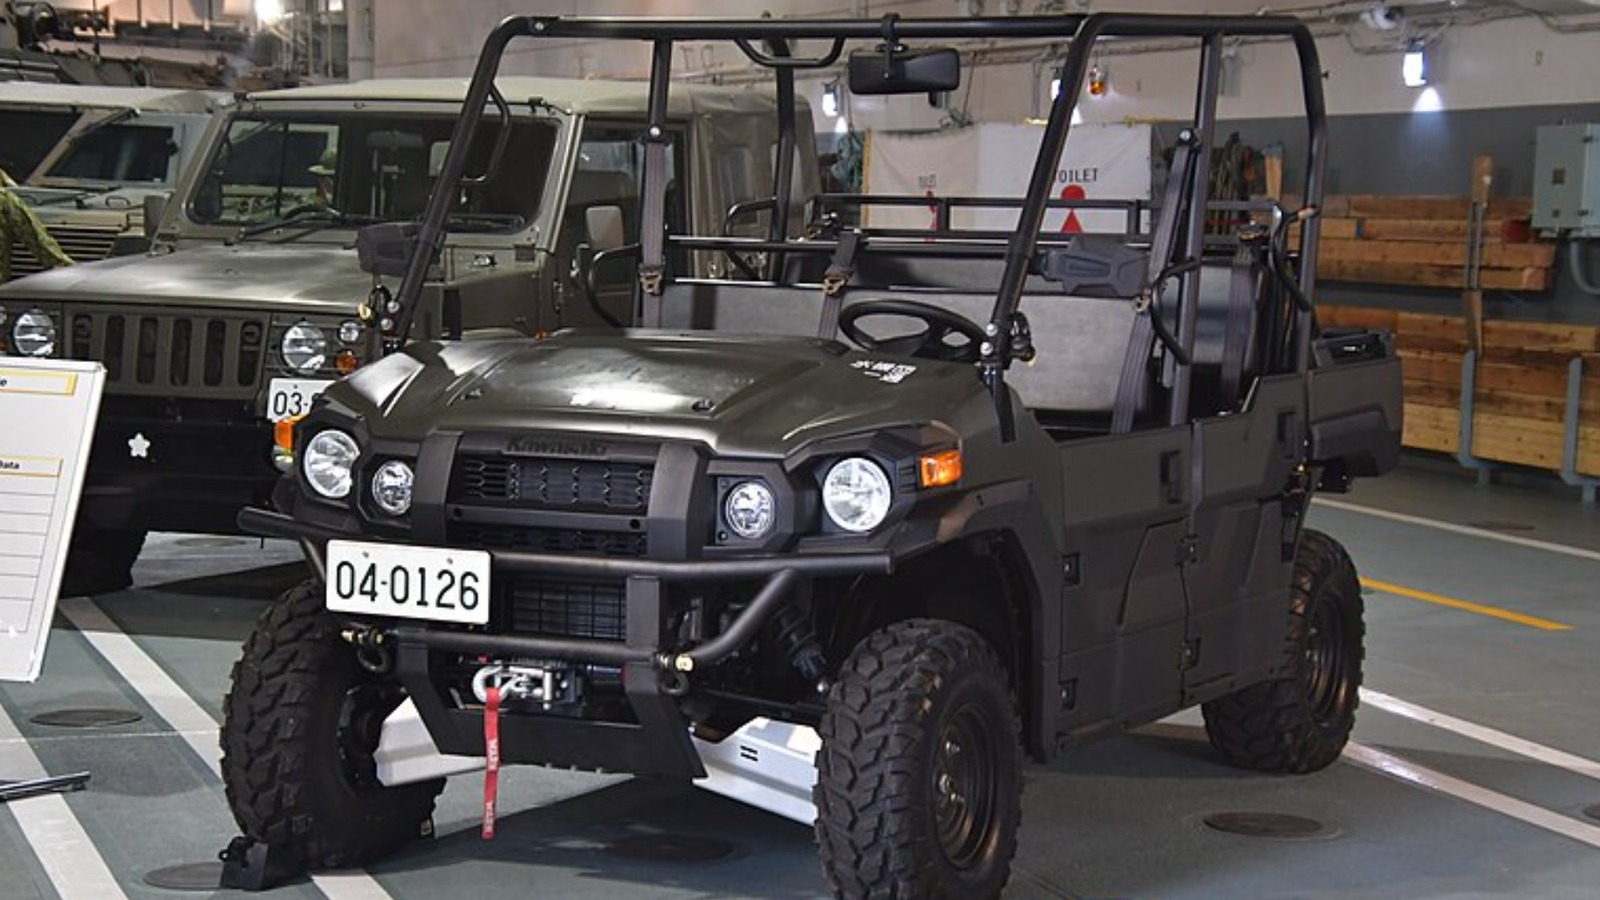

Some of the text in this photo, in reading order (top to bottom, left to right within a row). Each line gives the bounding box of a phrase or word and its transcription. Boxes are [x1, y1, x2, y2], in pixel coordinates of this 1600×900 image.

[1056, 168, 1098, 183] OILET
[273, 391, 319, 416] 03-
[336, 561, 479, 610] 04-0126
